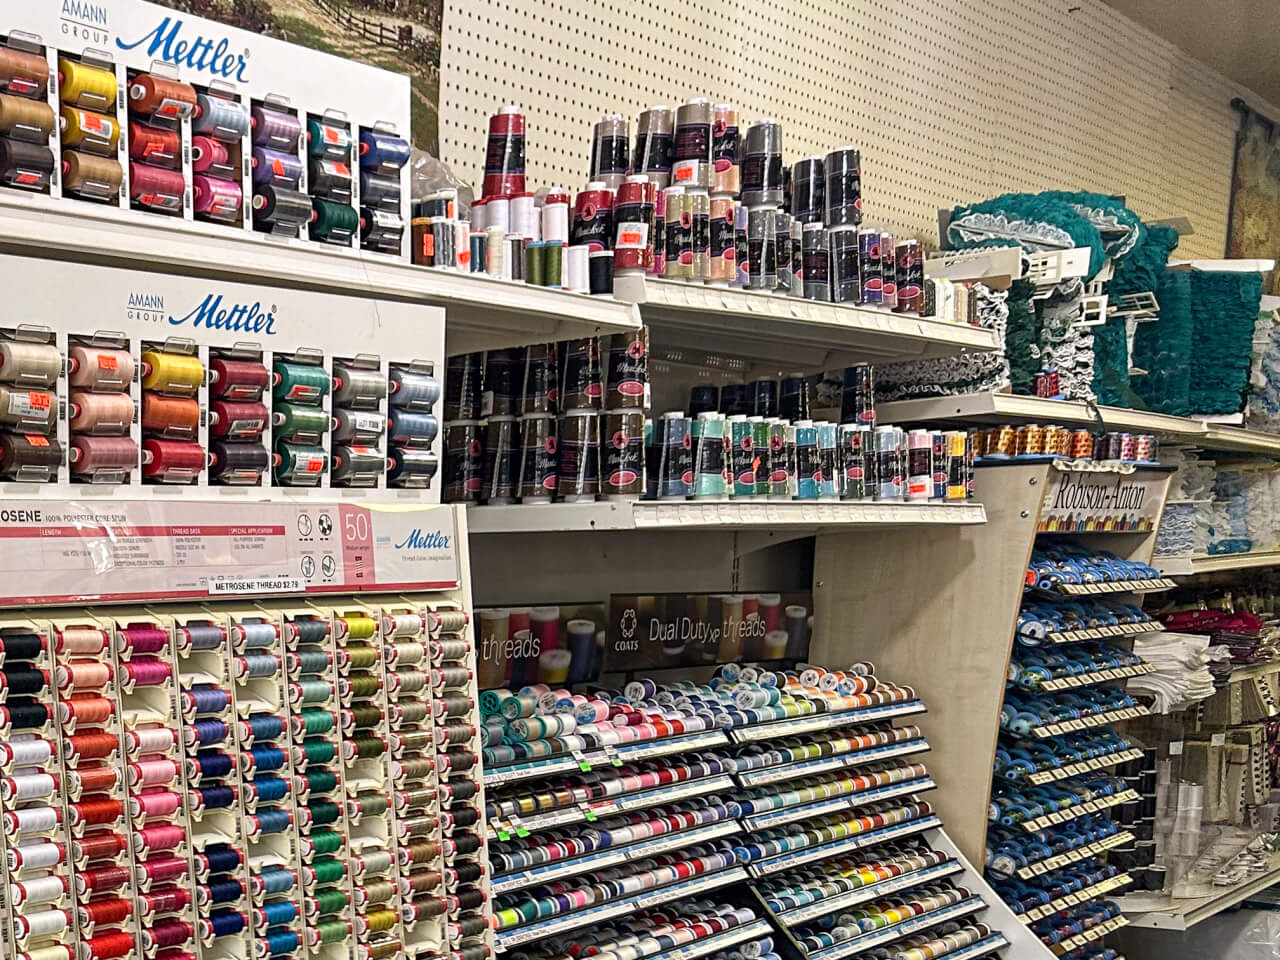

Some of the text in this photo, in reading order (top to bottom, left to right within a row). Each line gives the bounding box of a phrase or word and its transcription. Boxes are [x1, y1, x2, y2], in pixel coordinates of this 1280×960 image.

[62, 0, 107, 25] AMANN
[62, 23, 108, 45] GROUP
[115, 17, 249, 83] Mettler
[128, 293, 164, 309] AMANN
[128, 311, 164, 322] GROUP
[169, 294, 276, 334] Mettler
[1054, 473, 1146, 510] Robison-Anton
[345, 513, 368, 541] 50
[394, 528, 451, 549] Mettler
[216, 583, 256, 591] METROSENE
[649, 618, 679, 641] Dual
[681, 617, 711, 642] Duty
[723, 617, 766, 640] threads
[483, 634, 540, 661] threads
[615, 640, 639, 651] COATS
